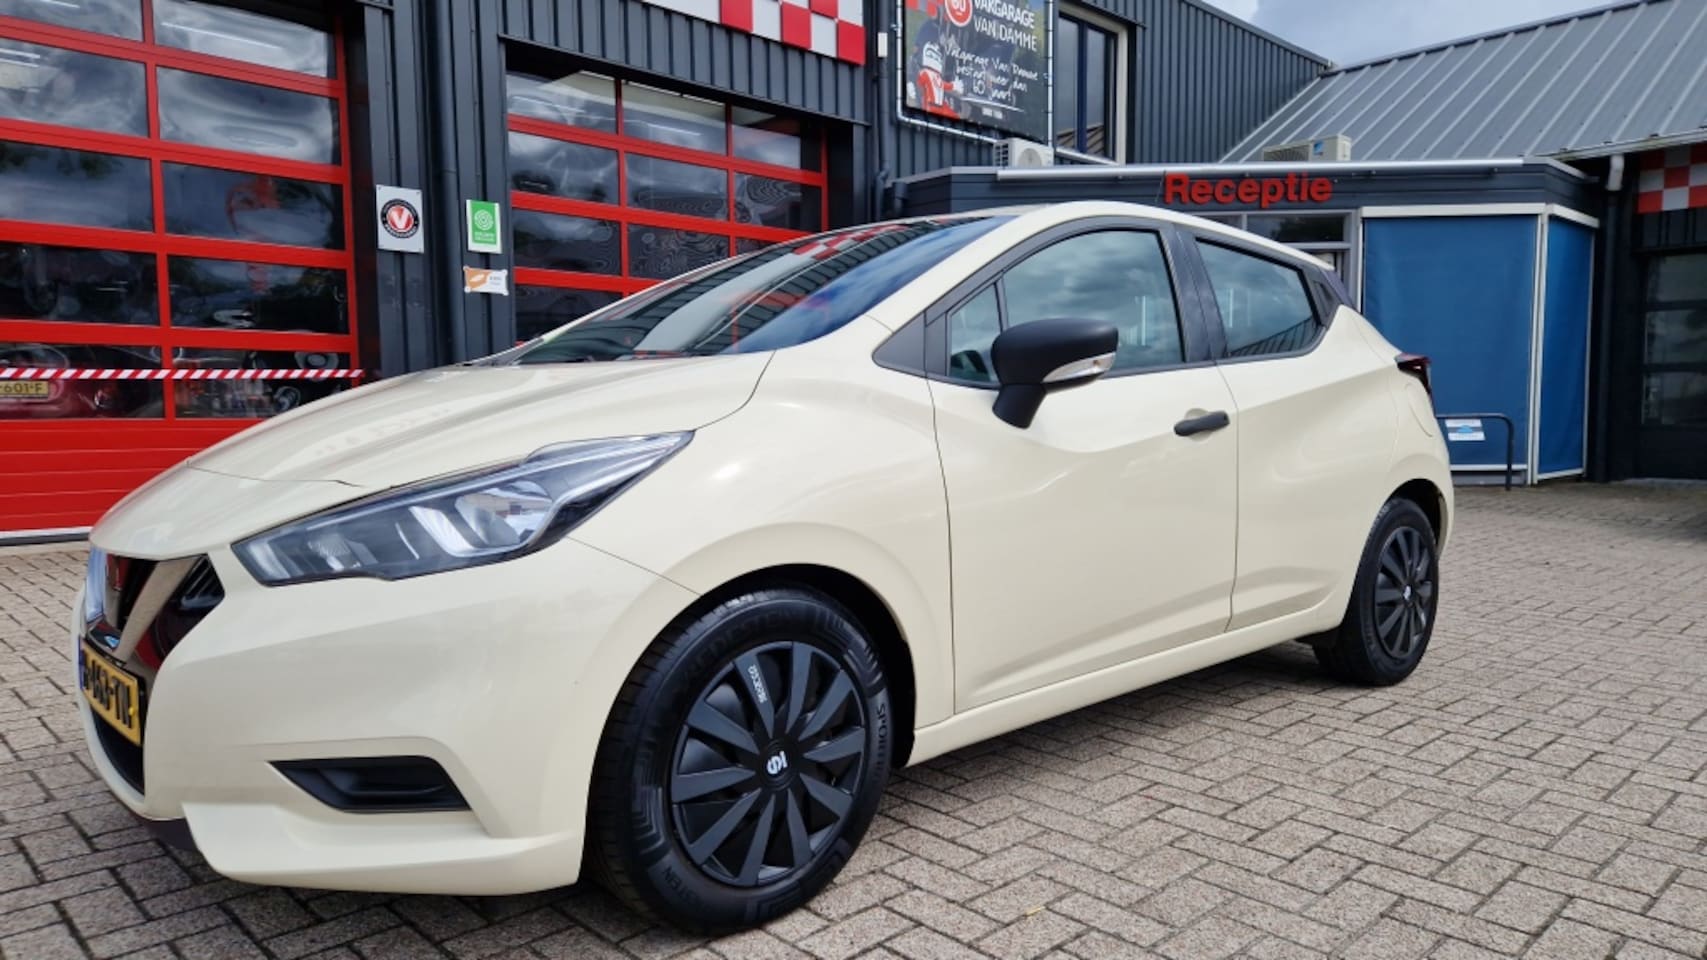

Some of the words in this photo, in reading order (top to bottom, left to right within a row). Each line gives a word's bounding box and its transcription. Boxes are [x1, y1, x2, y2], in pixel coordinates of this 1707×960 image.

[973, 15, 996, 38] VAN
[999, 24, 1038, 52] DAMME
[1164, 171, 1333, 208] Receptie
